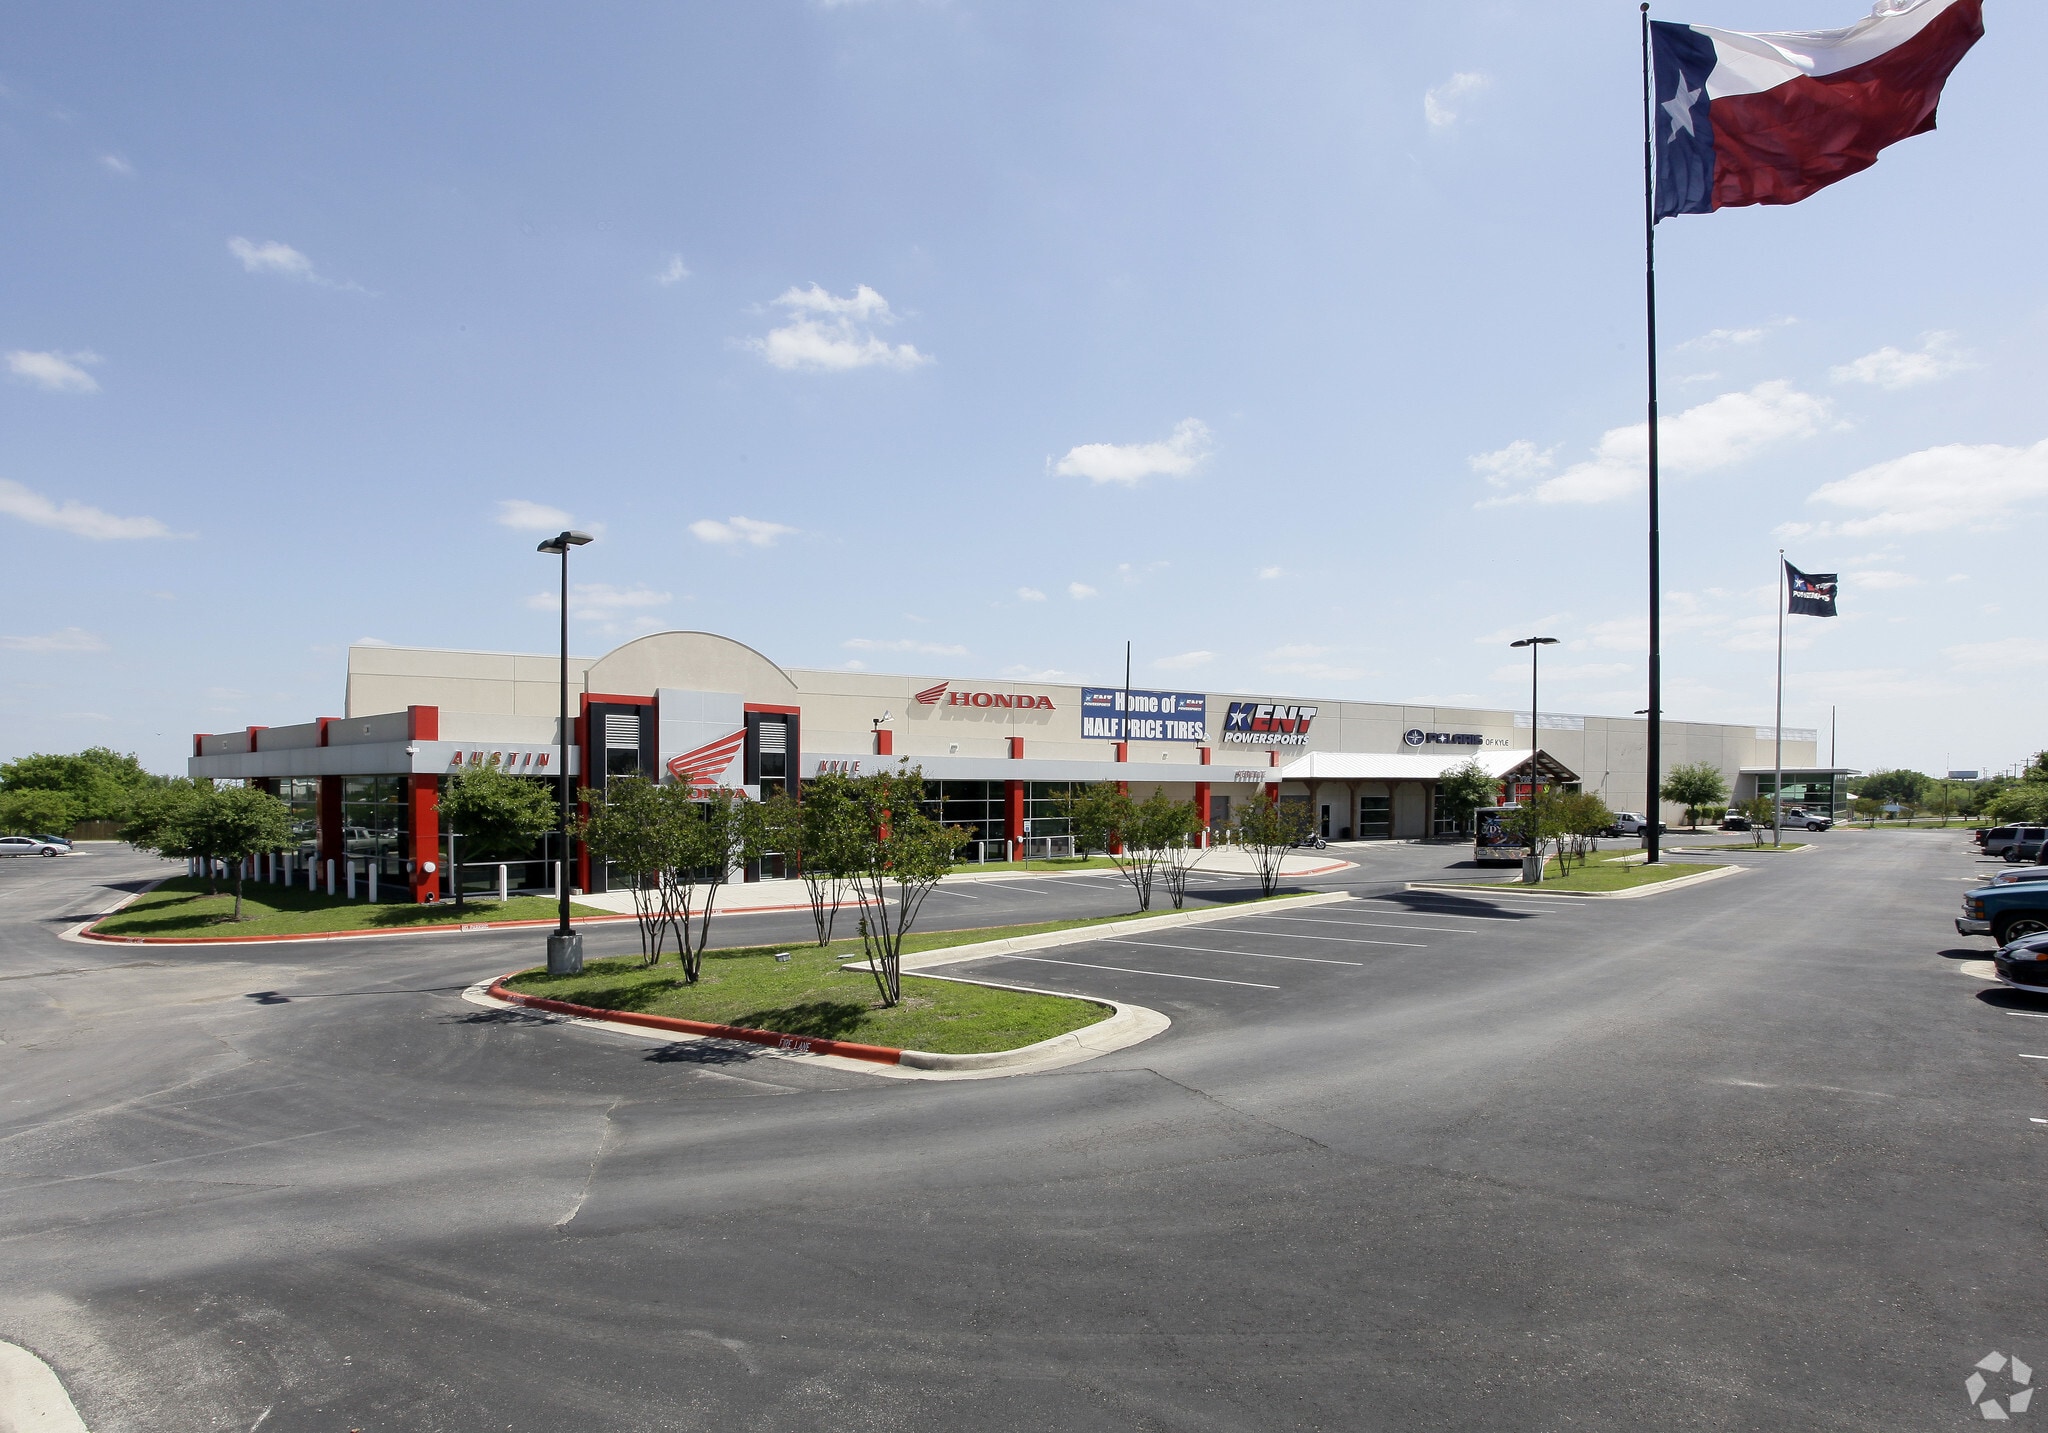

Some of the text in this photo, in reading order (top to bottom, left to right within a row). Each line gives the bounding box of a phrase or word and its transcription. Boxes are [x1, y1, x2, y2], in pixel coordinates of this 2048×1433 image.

[948, 691, 1057, 710] HONDA
[1115, 692, 1176, 714] Home of
[1224, 702, 1318, 733] KENT
[1083, 717, 1204, 741] HALF PRICE TIRES
[1224, 732, 1310, 745] POWERSPORTS
[1426, 733, 1509, 747] POLARIS OF KYLE
[451, 750, 550, 767] AUSTIN
[820, 760, 861, 772] KYLE
[686, 787, 749, 799] ONDA
[779, 1038, 811, 1052] FIRE LANE
